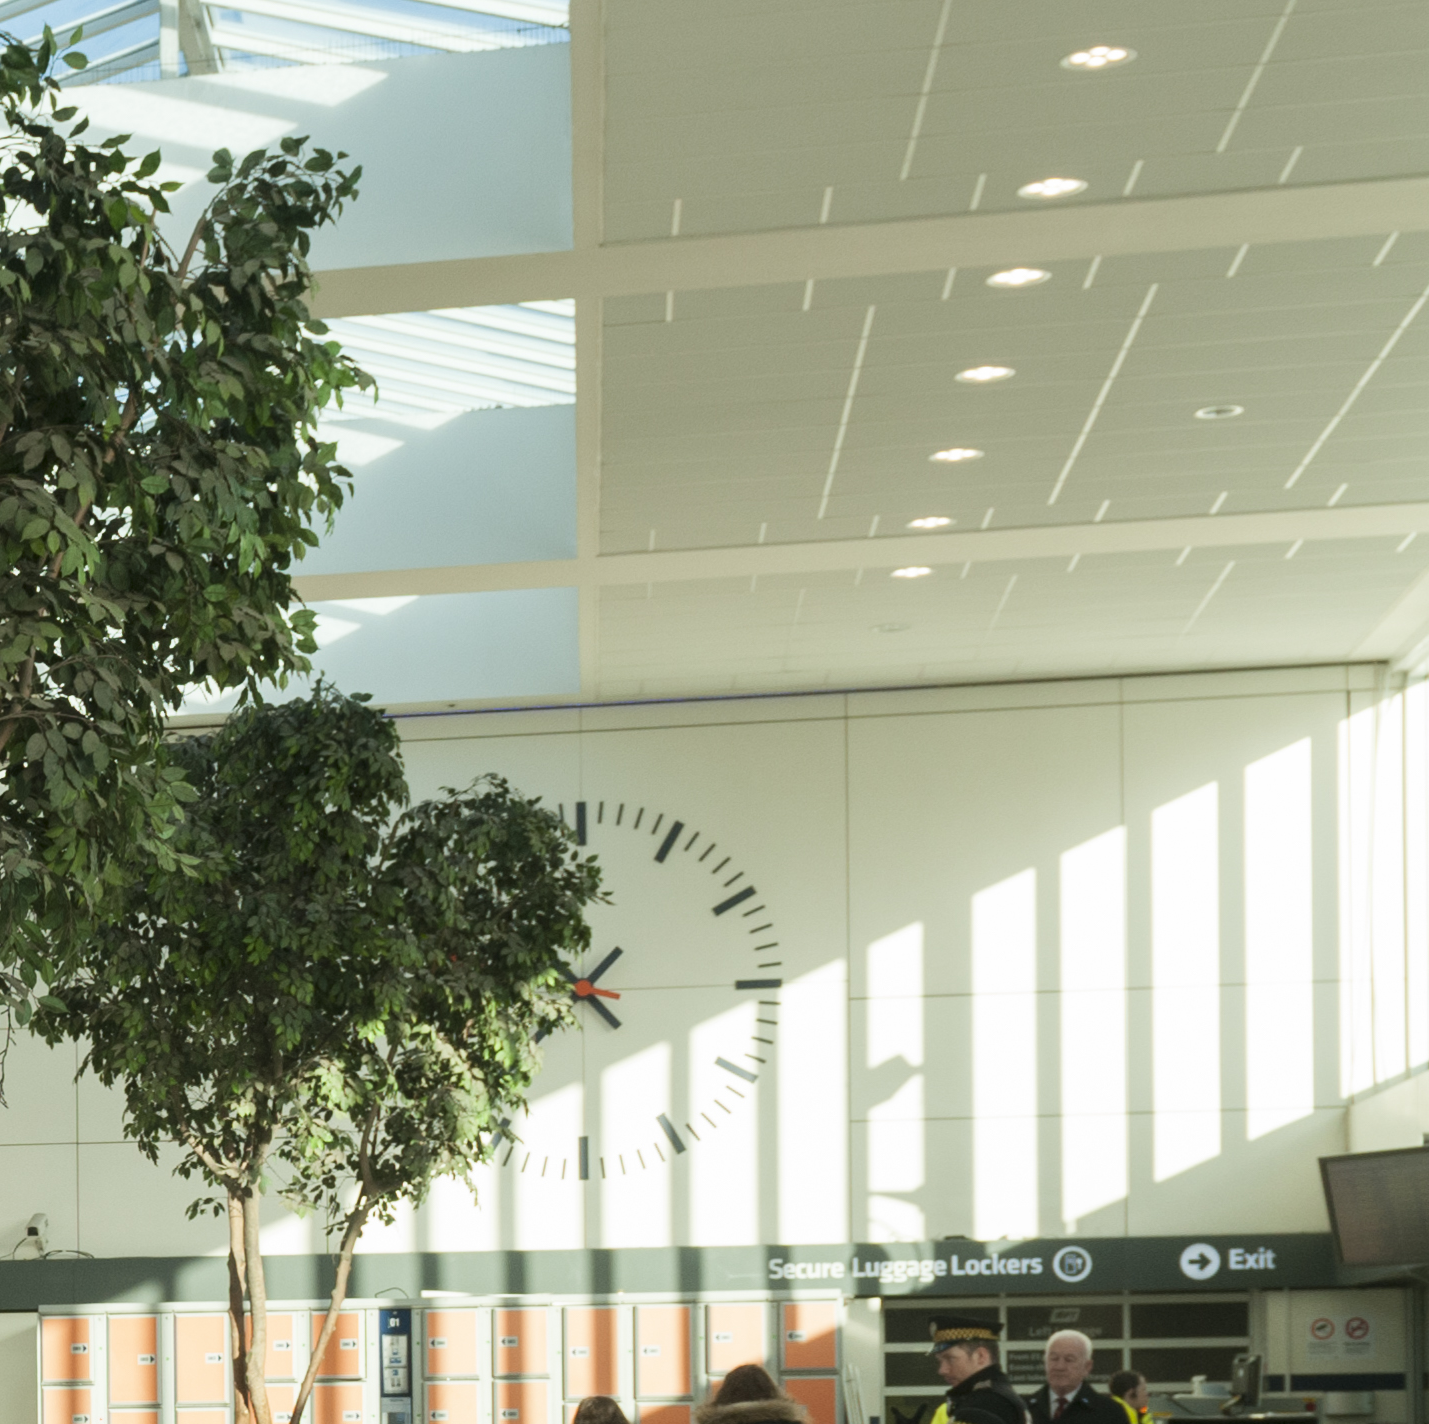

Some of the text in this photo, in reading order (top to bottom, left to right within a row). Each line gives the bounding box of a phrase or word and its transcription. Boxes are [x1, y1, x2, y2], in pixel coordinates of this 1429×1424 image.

[769, 1253, 1043, 1286] Secure Luggage Lockers
[1228, 1247, 1276, 1271] Exit
